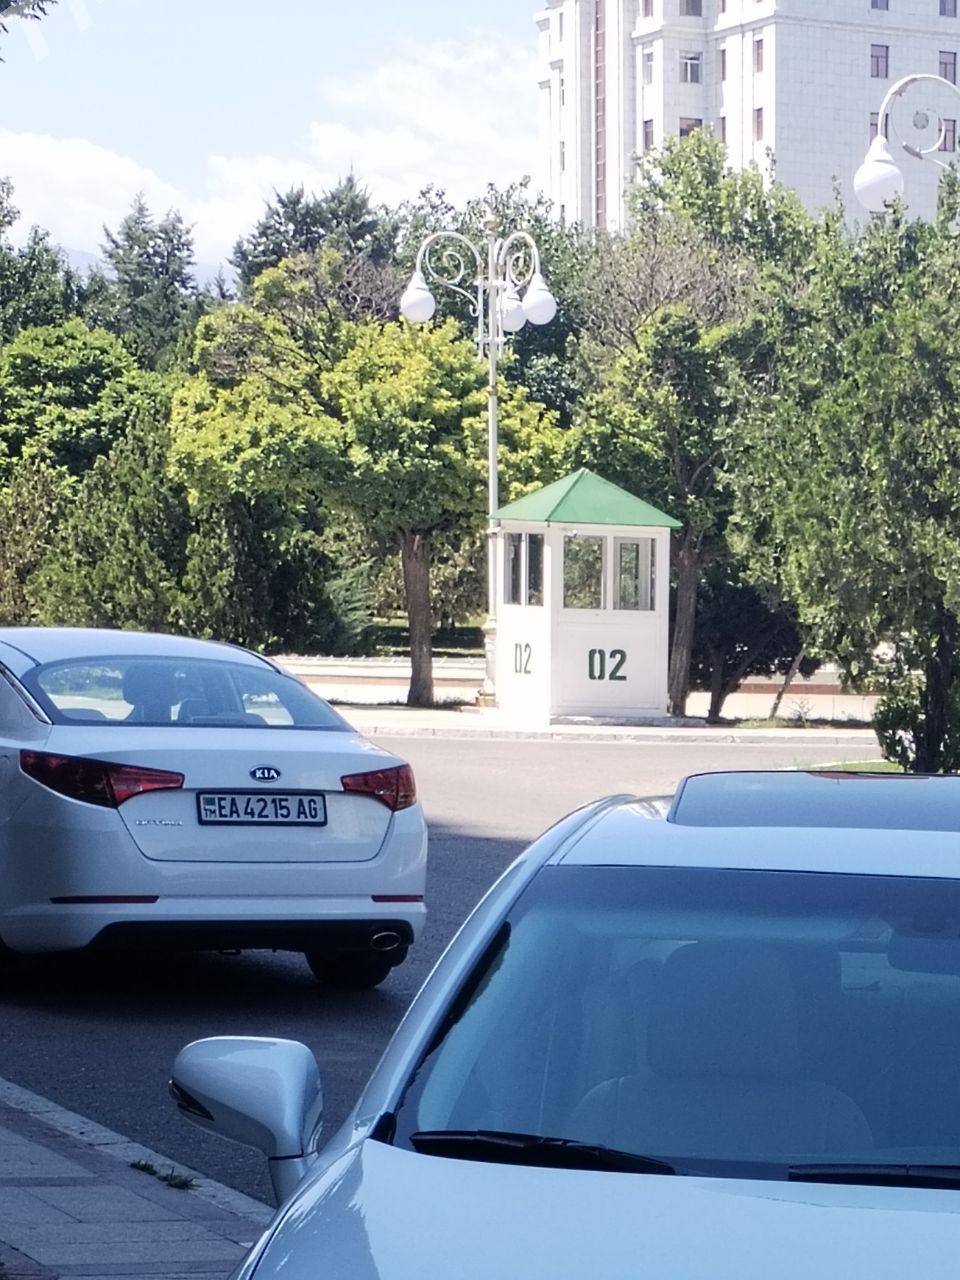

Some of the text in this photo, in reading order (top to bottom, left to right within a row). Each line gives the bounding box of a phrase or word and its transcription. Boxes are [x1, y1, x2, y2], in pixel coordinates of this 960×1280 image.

[514, 643, 532, 674] 02
[588, 648, 627, 681] 02
[256, 769, 278, 779] KIA
[217, 797, 240, 818] EA
[297, 799, 318, 819] AG
